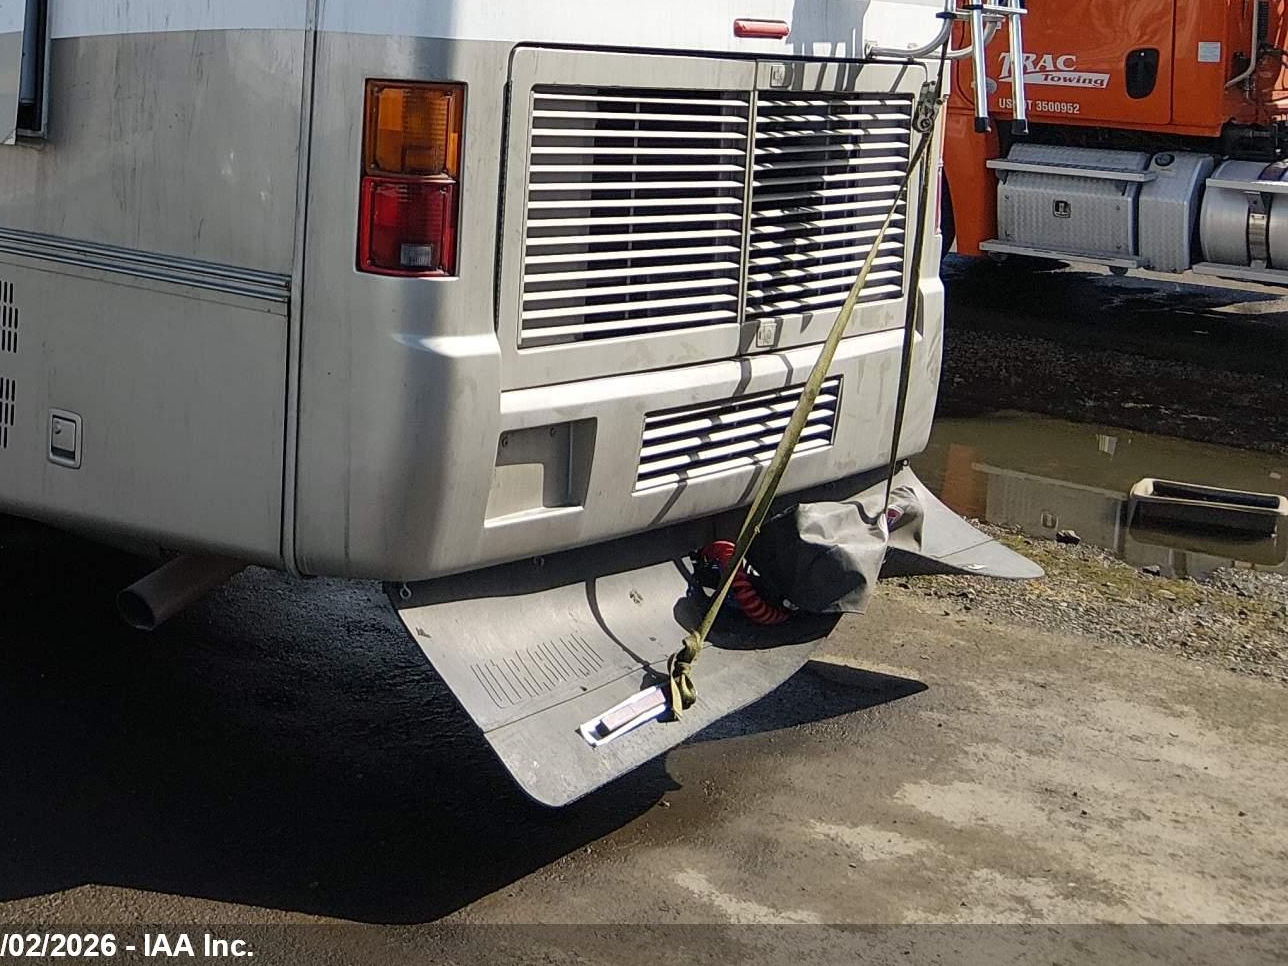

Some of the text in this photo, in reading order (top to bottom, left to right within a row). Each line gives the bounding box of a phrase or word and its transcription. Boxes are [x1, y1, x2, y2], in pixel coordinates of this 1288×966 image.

[997, 52, 1077, 79] TRAC
[1042, 73, 1106, 88] Towing
[998, 97, 1081, 114] UST 3500952
